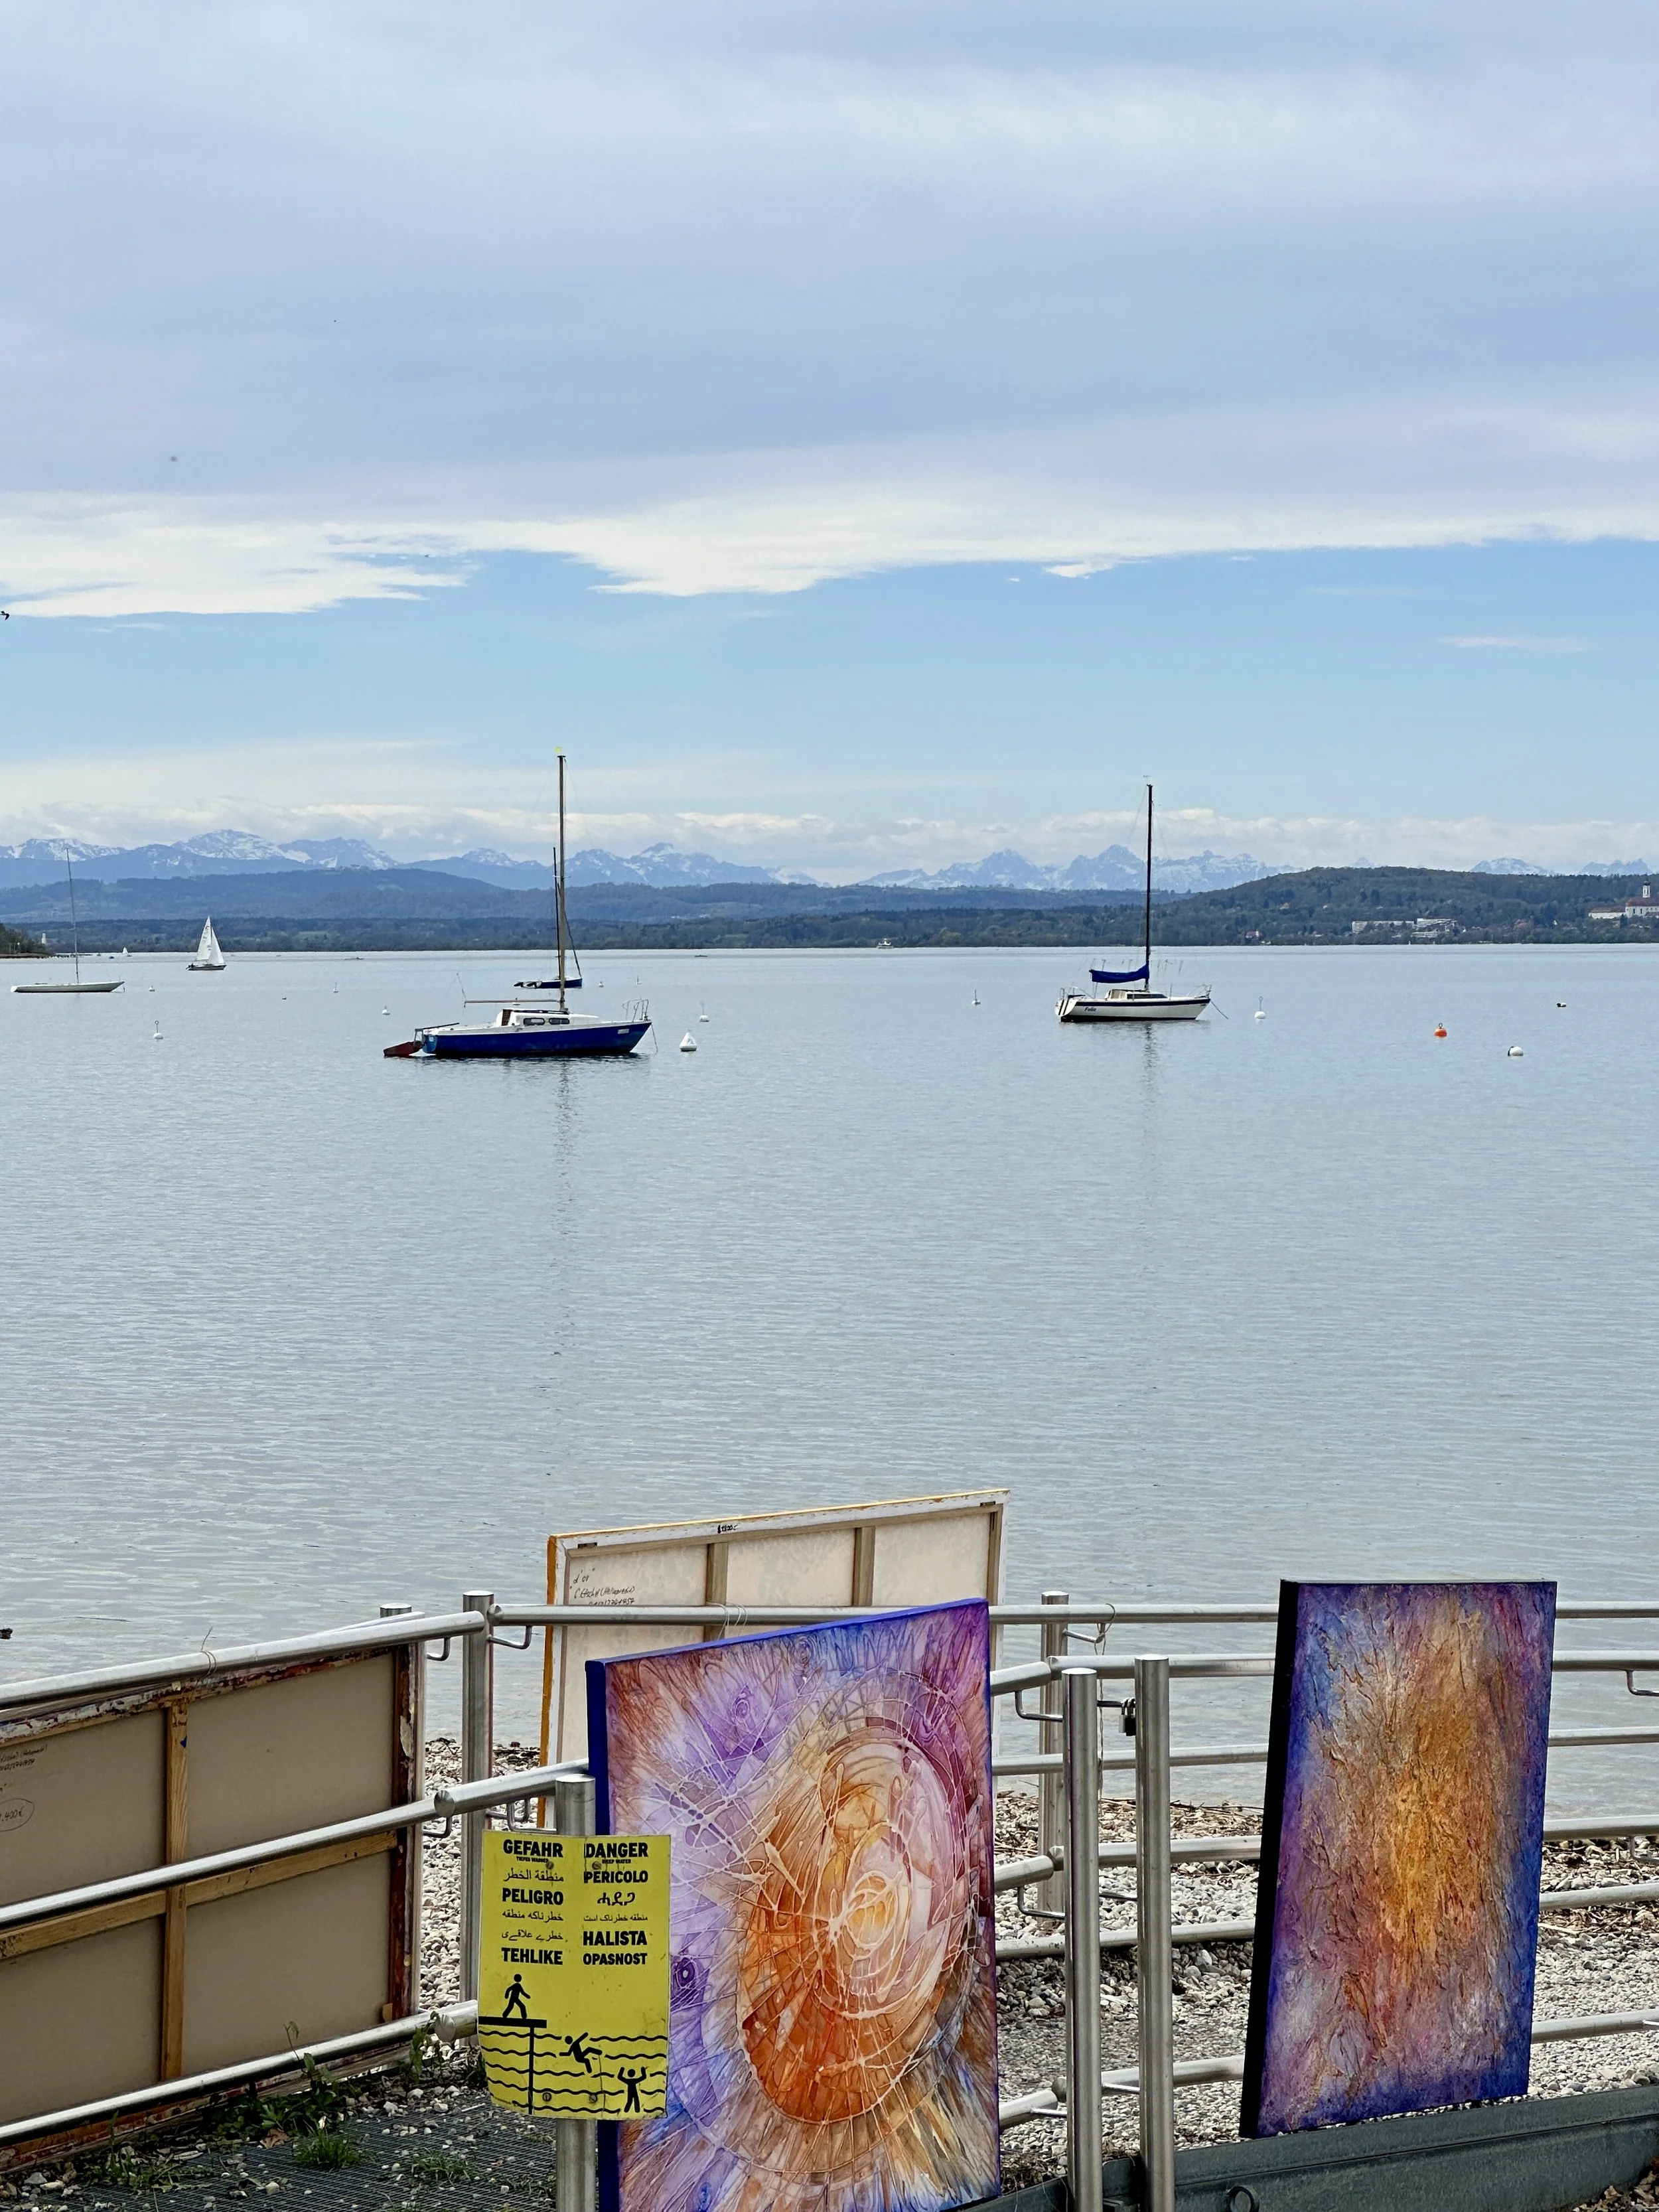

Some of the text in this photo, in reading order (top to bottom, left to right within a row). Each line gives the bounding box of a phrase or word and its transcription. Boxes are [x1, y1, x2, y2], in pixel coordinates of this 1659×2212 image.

[503, 1839, 563, 1858] GEFAHR
[584, 1842, 648, 1858] DANGER
[503, 1867, 564, 1882] منطقة الخطر
[583, 1870, 648, 1883] PERICOLO
[502, 1887, 564, 1905] PELIGRO
[583, 1930, 648, 1946] HALISTA
[501, 1947, 563, 1965] TEHLIKE
[583, 1953, 648, 1965] OPASNOST
